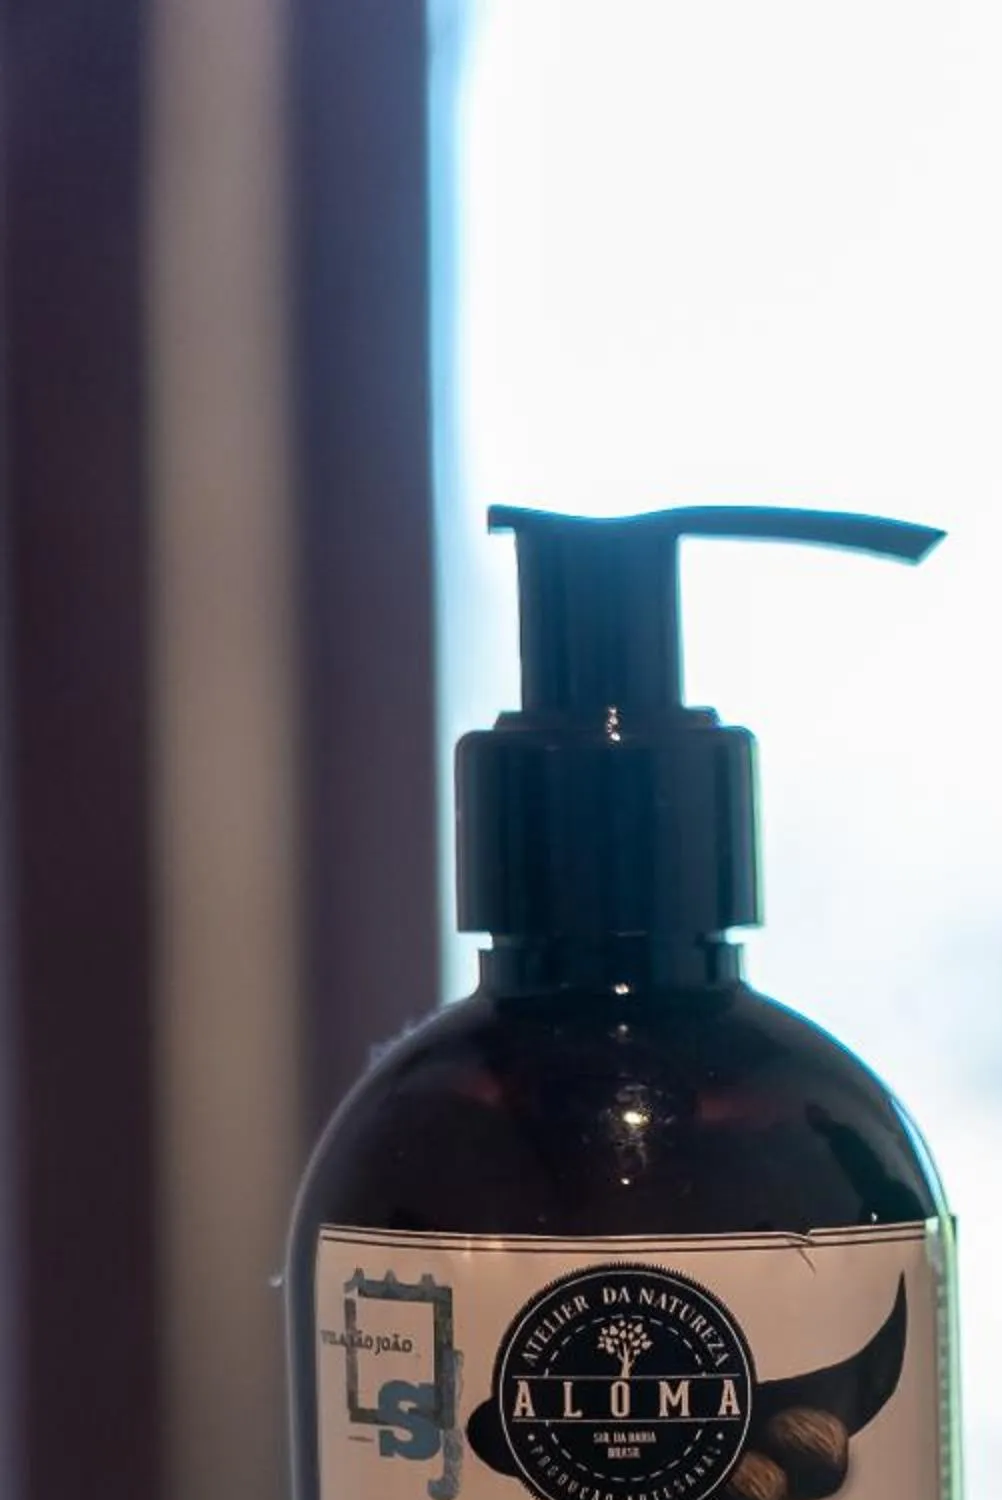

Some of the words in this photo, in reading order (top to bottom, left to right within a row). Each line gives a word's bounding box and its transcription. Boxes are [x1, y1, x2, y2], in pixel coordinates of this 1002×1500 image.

[521, 1295, 590, 1367] ATELIER
[602, 1286, 631, 1305] DA
[639, 1287, 730, 1367] NATUREZA
[512, 1379, 741, 1419] ALOMA
